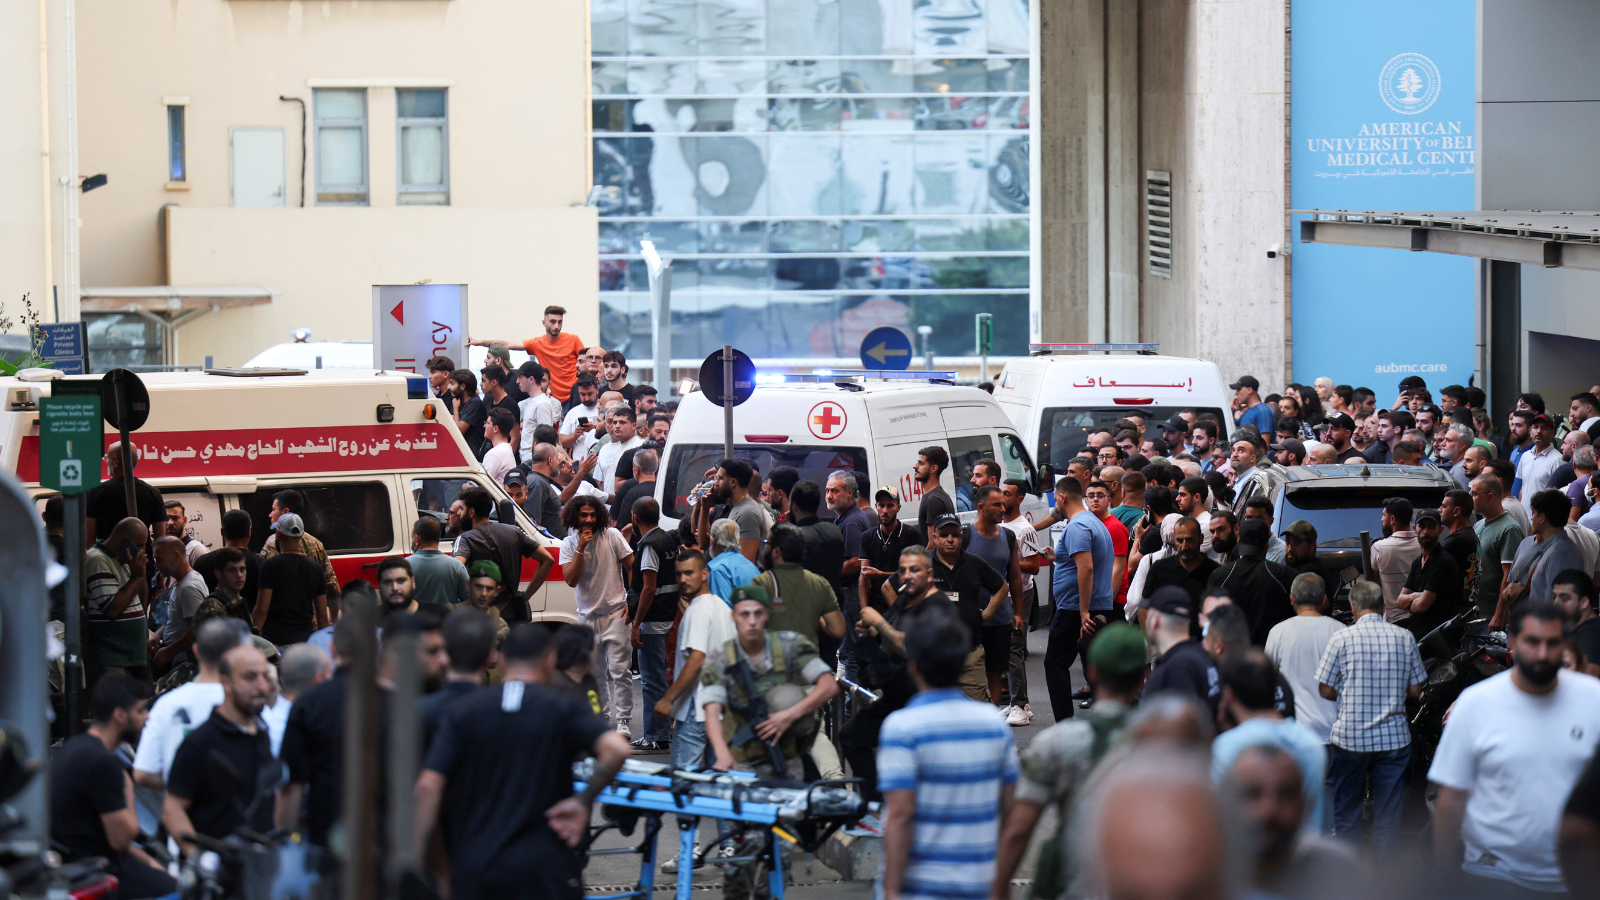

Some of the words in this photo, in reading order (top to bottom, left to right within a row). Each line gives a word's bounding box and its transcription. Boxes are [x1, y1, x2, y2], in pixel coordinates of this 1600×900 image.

[1358, 121, 1462, 136] AMERICAN
[1307, 136, 1425, 152] UNIVERSITY
[1425, 139, 1440, 148] OF
[1441, 136, 1474, 149] BEI
[1326, 152, 1413, 167] MEDICAL
[1450, 168, 1474, 177] لطبي
[1374, 362, 1447, 373] aubmc.care
[1073, 377, 1193, 392] إسعاف
[247, 439, 283, 460] الحاج
[287, 436, 337, 458] الشهيد
[338, 440, 367, 457] روح
[368, 438, 390, 456] عن
[394, 432, 438, 451] تقدمة
[161, 445, 197, 464] حسن
[200, 442, 245, 464] مهدي
